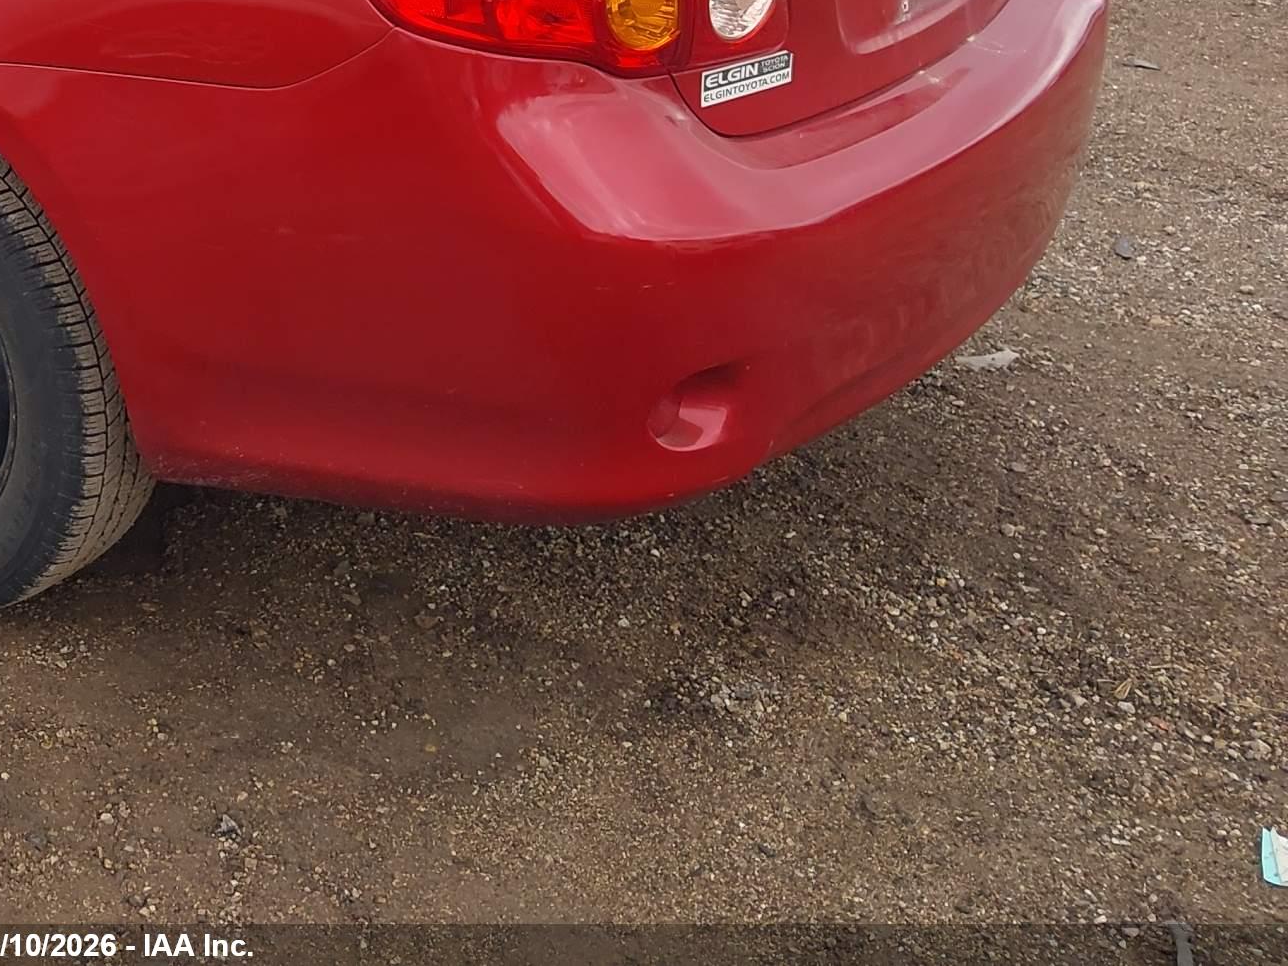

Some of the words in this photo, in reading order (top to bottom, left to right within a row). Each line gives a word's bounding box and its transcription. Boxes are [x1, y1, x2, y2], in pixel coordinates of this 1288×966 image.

[704, 70, 790, 102] ELGINTOYOTA.COM
[705, 62, 759, 88] ELGIN
[761, 54, 789, 68] TOYOTA
